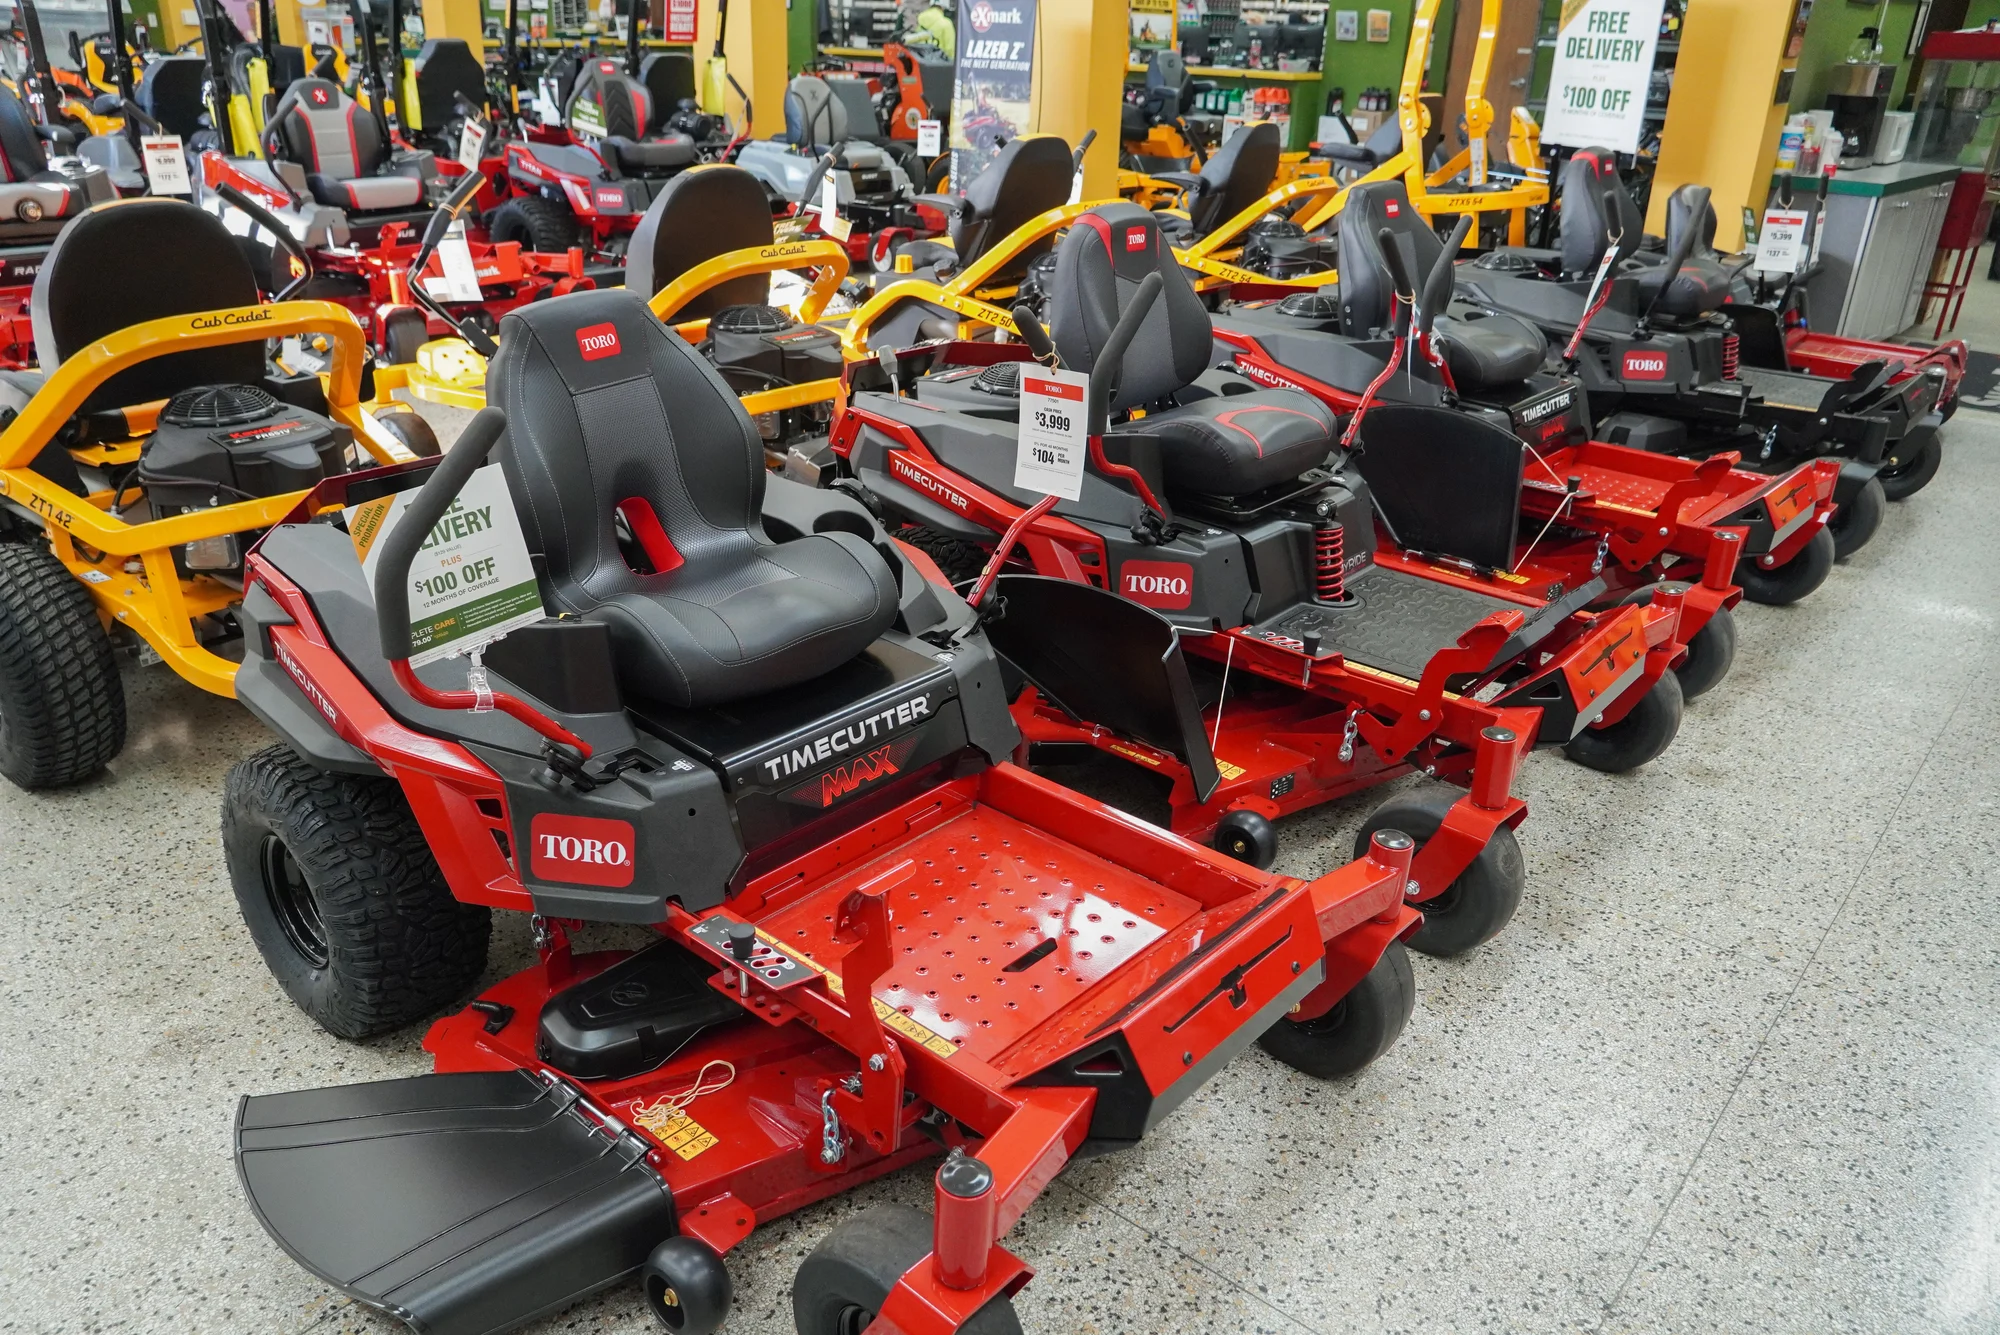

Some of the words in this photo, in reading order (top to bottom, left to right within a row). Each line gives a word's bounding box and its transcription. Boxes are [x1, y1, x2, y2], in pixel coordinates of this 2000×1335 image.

[1588, 11, 1630, 34] FREE
[966, 40, 1009, 59] LAZER
[1566, 38, 1645, 62] DELIVERY
[961, 58, 973, 68] THE
[973, 59, 990, 69] NEXT
[990, 60, 1030, 72] GENERATION
[1563, 85, 1597, 109] $100
[1601, 89, 1631, 112] OFF
[1128, 233, 1146, 245] TORO
[761, 249, 778, 258] Cub
[779, 245, 806, 256] Cadet
[1219, 267, 1239, 281] ZT2
[1240, 273, 1252, 283] 54
[191, 315, 222, 330] Cub
[223, 309, 272, 325] Cadet
[978, 307, 999, 323] ZT2
[1000, 315, 1013, 328] 50
[582, 333, 616, 352] TORO
[1626, 359, 1664, 372] TORO
[1044, 384, 1062, 394] TORO
[1522, 393, 1570, 423] TIMECUTTER
[1035, 411, 1070, 431] $3,999
[1032, 448, 1054, 465] $104
[894, 459, 967, 511] TIMECUTTER
[30, 492, 53, 518] ZT1
[55, 510, 73, 529] 42
[353, 507, 373, 537] SPECIAL
[359, 503, 385, 548] PROMOTION
[441, 554, 462, 567] PLUS
[415, 571, 458, 598] $100
[462, 556, 495, 584] OFF
[1126, 574, 1187, 595] TORO
[423, 601, 430, 609] 12
[430, 592, 458, 606] MONTHS
[458, 588, 467, 597] OF
[467, 576, 500, 592] COVERAGE
[434, 617, 456, 631] CARE
[275, 641, 337, 725] TIMECUTTER
[765, 695, 930, 781] TIMECUTTER
[822, 745, 899, 807] MAX
[540, 834, 627, 866] TORO
